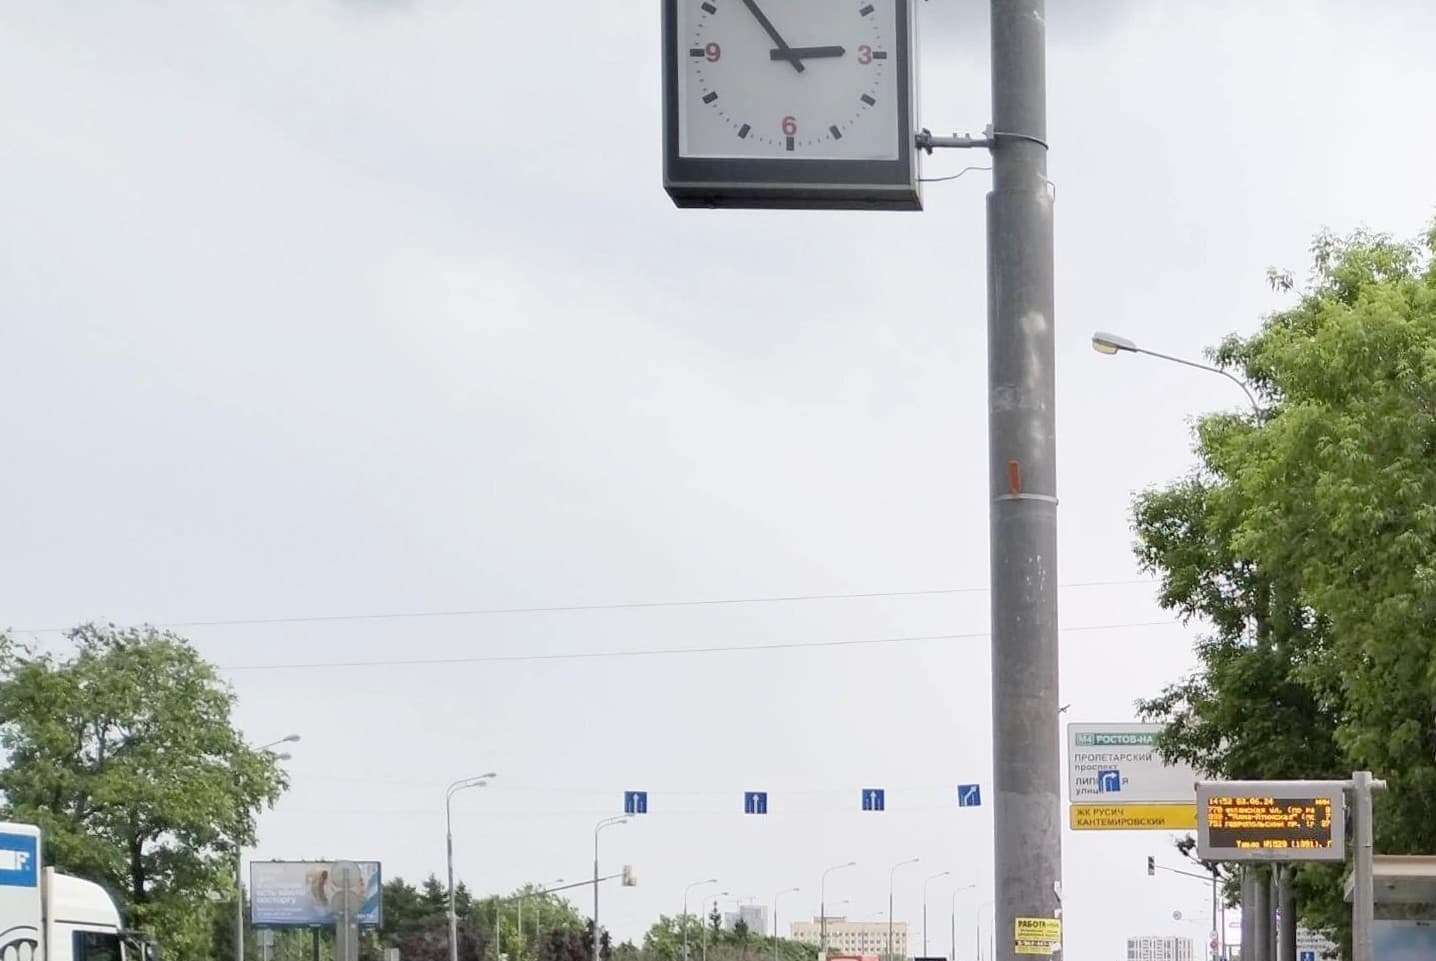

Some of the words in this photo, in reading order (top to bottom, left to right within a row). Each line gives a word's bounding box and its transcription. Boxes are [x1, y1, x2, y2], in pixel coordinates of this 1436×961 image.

[704, 43, 721, 62] 9
[857, 45, 872, 64] 3
[782, 116, 797, 136] 6
[1074, 753, 1152, 762] ПРОЛЕТАРСКИЙ
[1093, 808, 1124, 816] РУСИЧ
[1077, 817, 1165, 826] КАНТЕМИРОВСКИЙ
